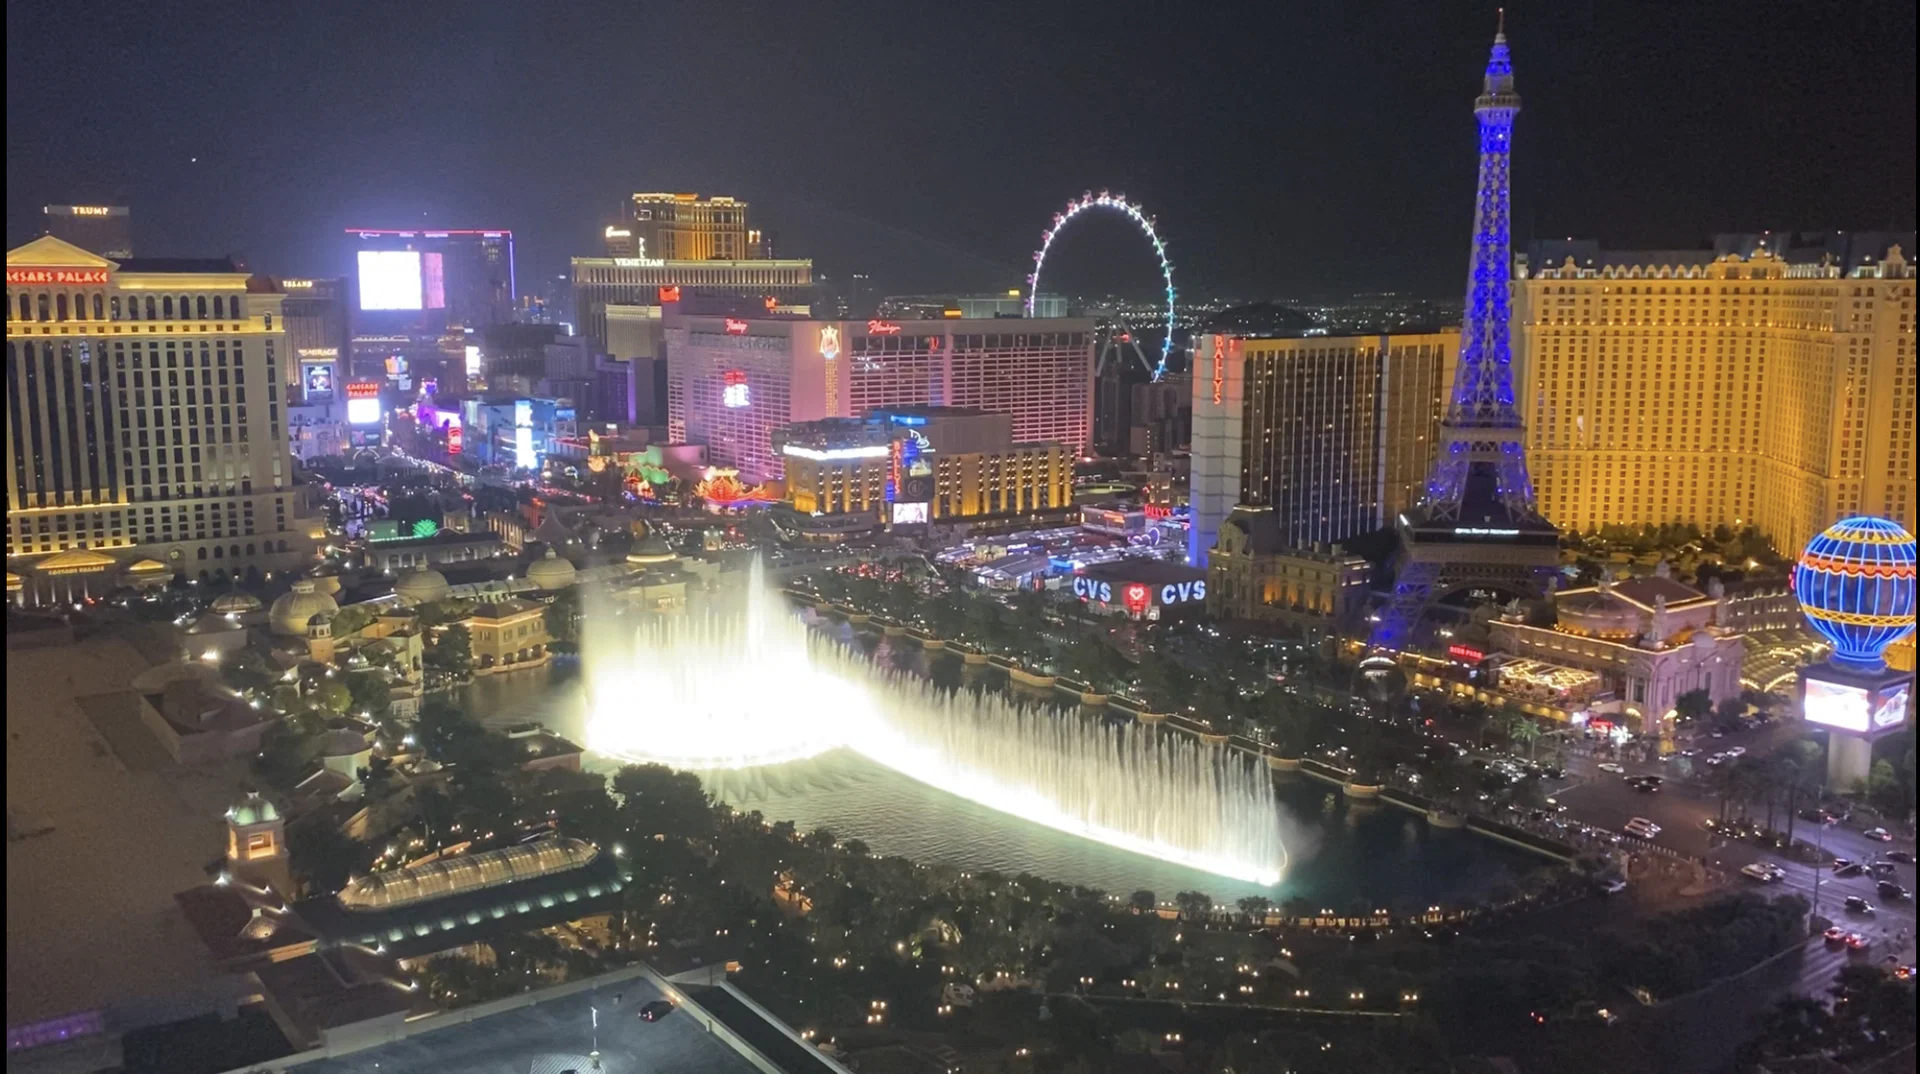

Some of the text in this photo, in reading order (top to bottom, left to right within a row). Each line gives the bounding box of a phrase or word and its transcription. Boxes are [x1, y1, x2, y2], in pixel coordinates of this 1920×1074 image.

[71, 206, 109, 216] TRUMP
[614, 258, 664, 267] VENETIAN
[57, 272, 108, 282] PALACE
[1073, 576, 1112, 602] CVS
[1161, 580, 1206, 604] CVS
